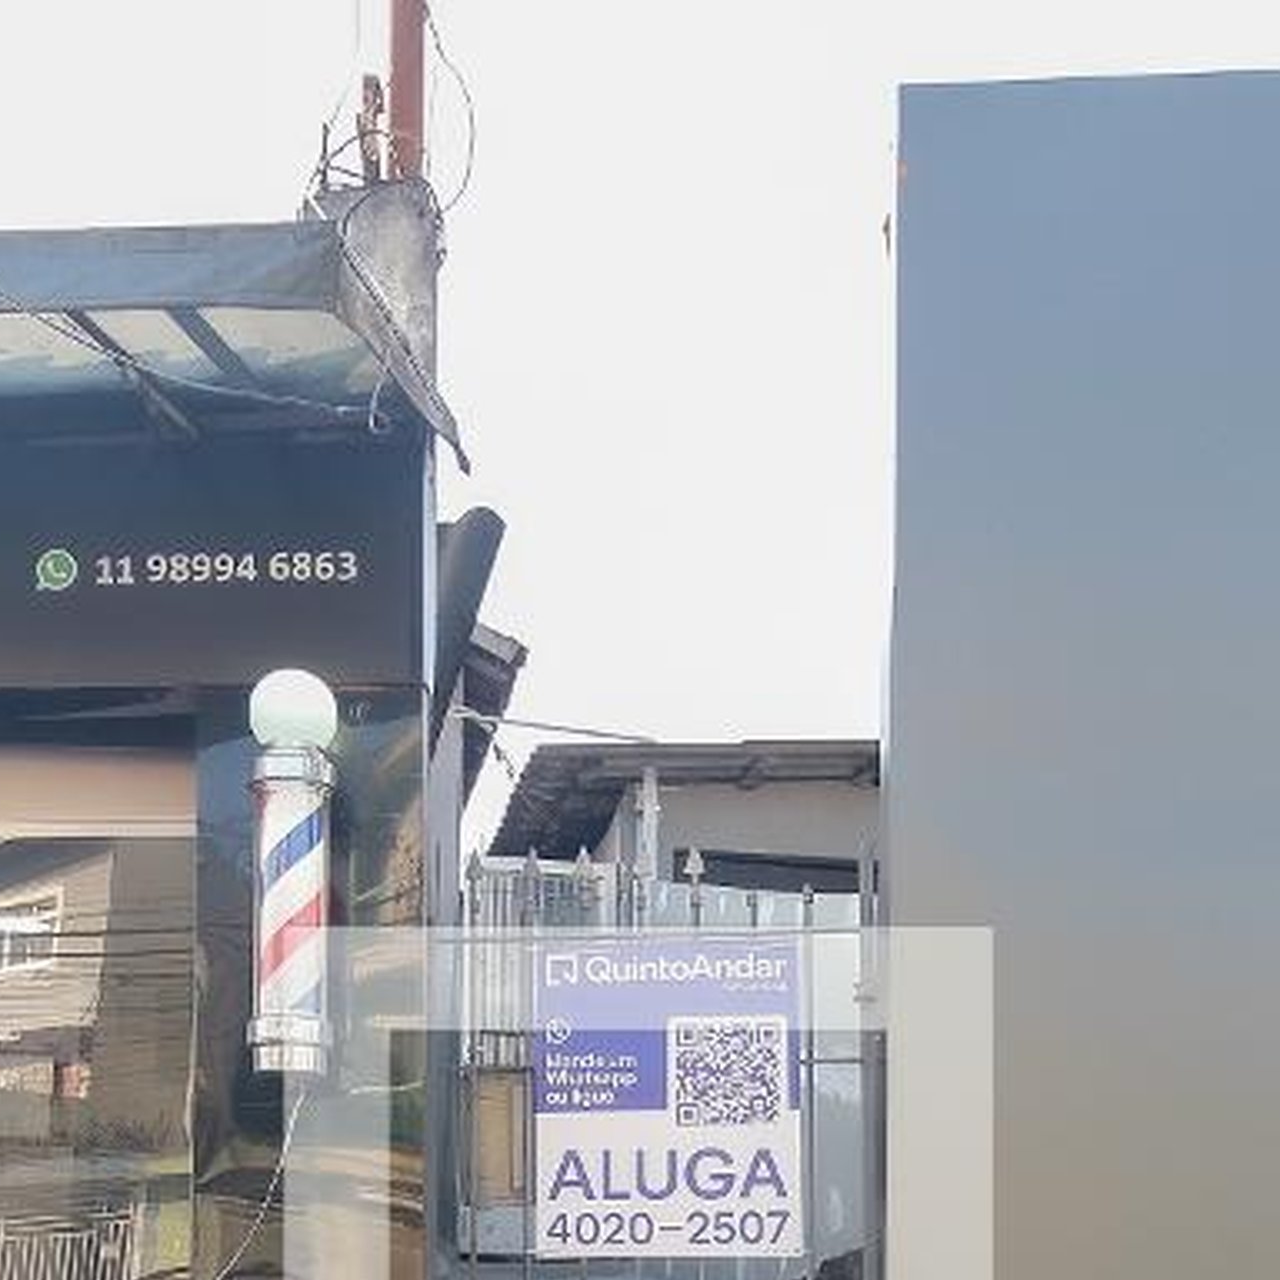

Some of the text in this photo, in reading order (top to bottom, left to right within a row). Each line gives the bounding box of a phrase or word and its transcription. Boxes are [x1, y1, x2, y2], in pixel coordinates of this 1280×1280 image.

[95, 551, 359, 584] 11 98994 6863
[585, 952, 788, 983] QuintoAndar
[548, 1147, 788, 1201] ALUGA
[546, 1209, 791, 1245] 4020-2507
